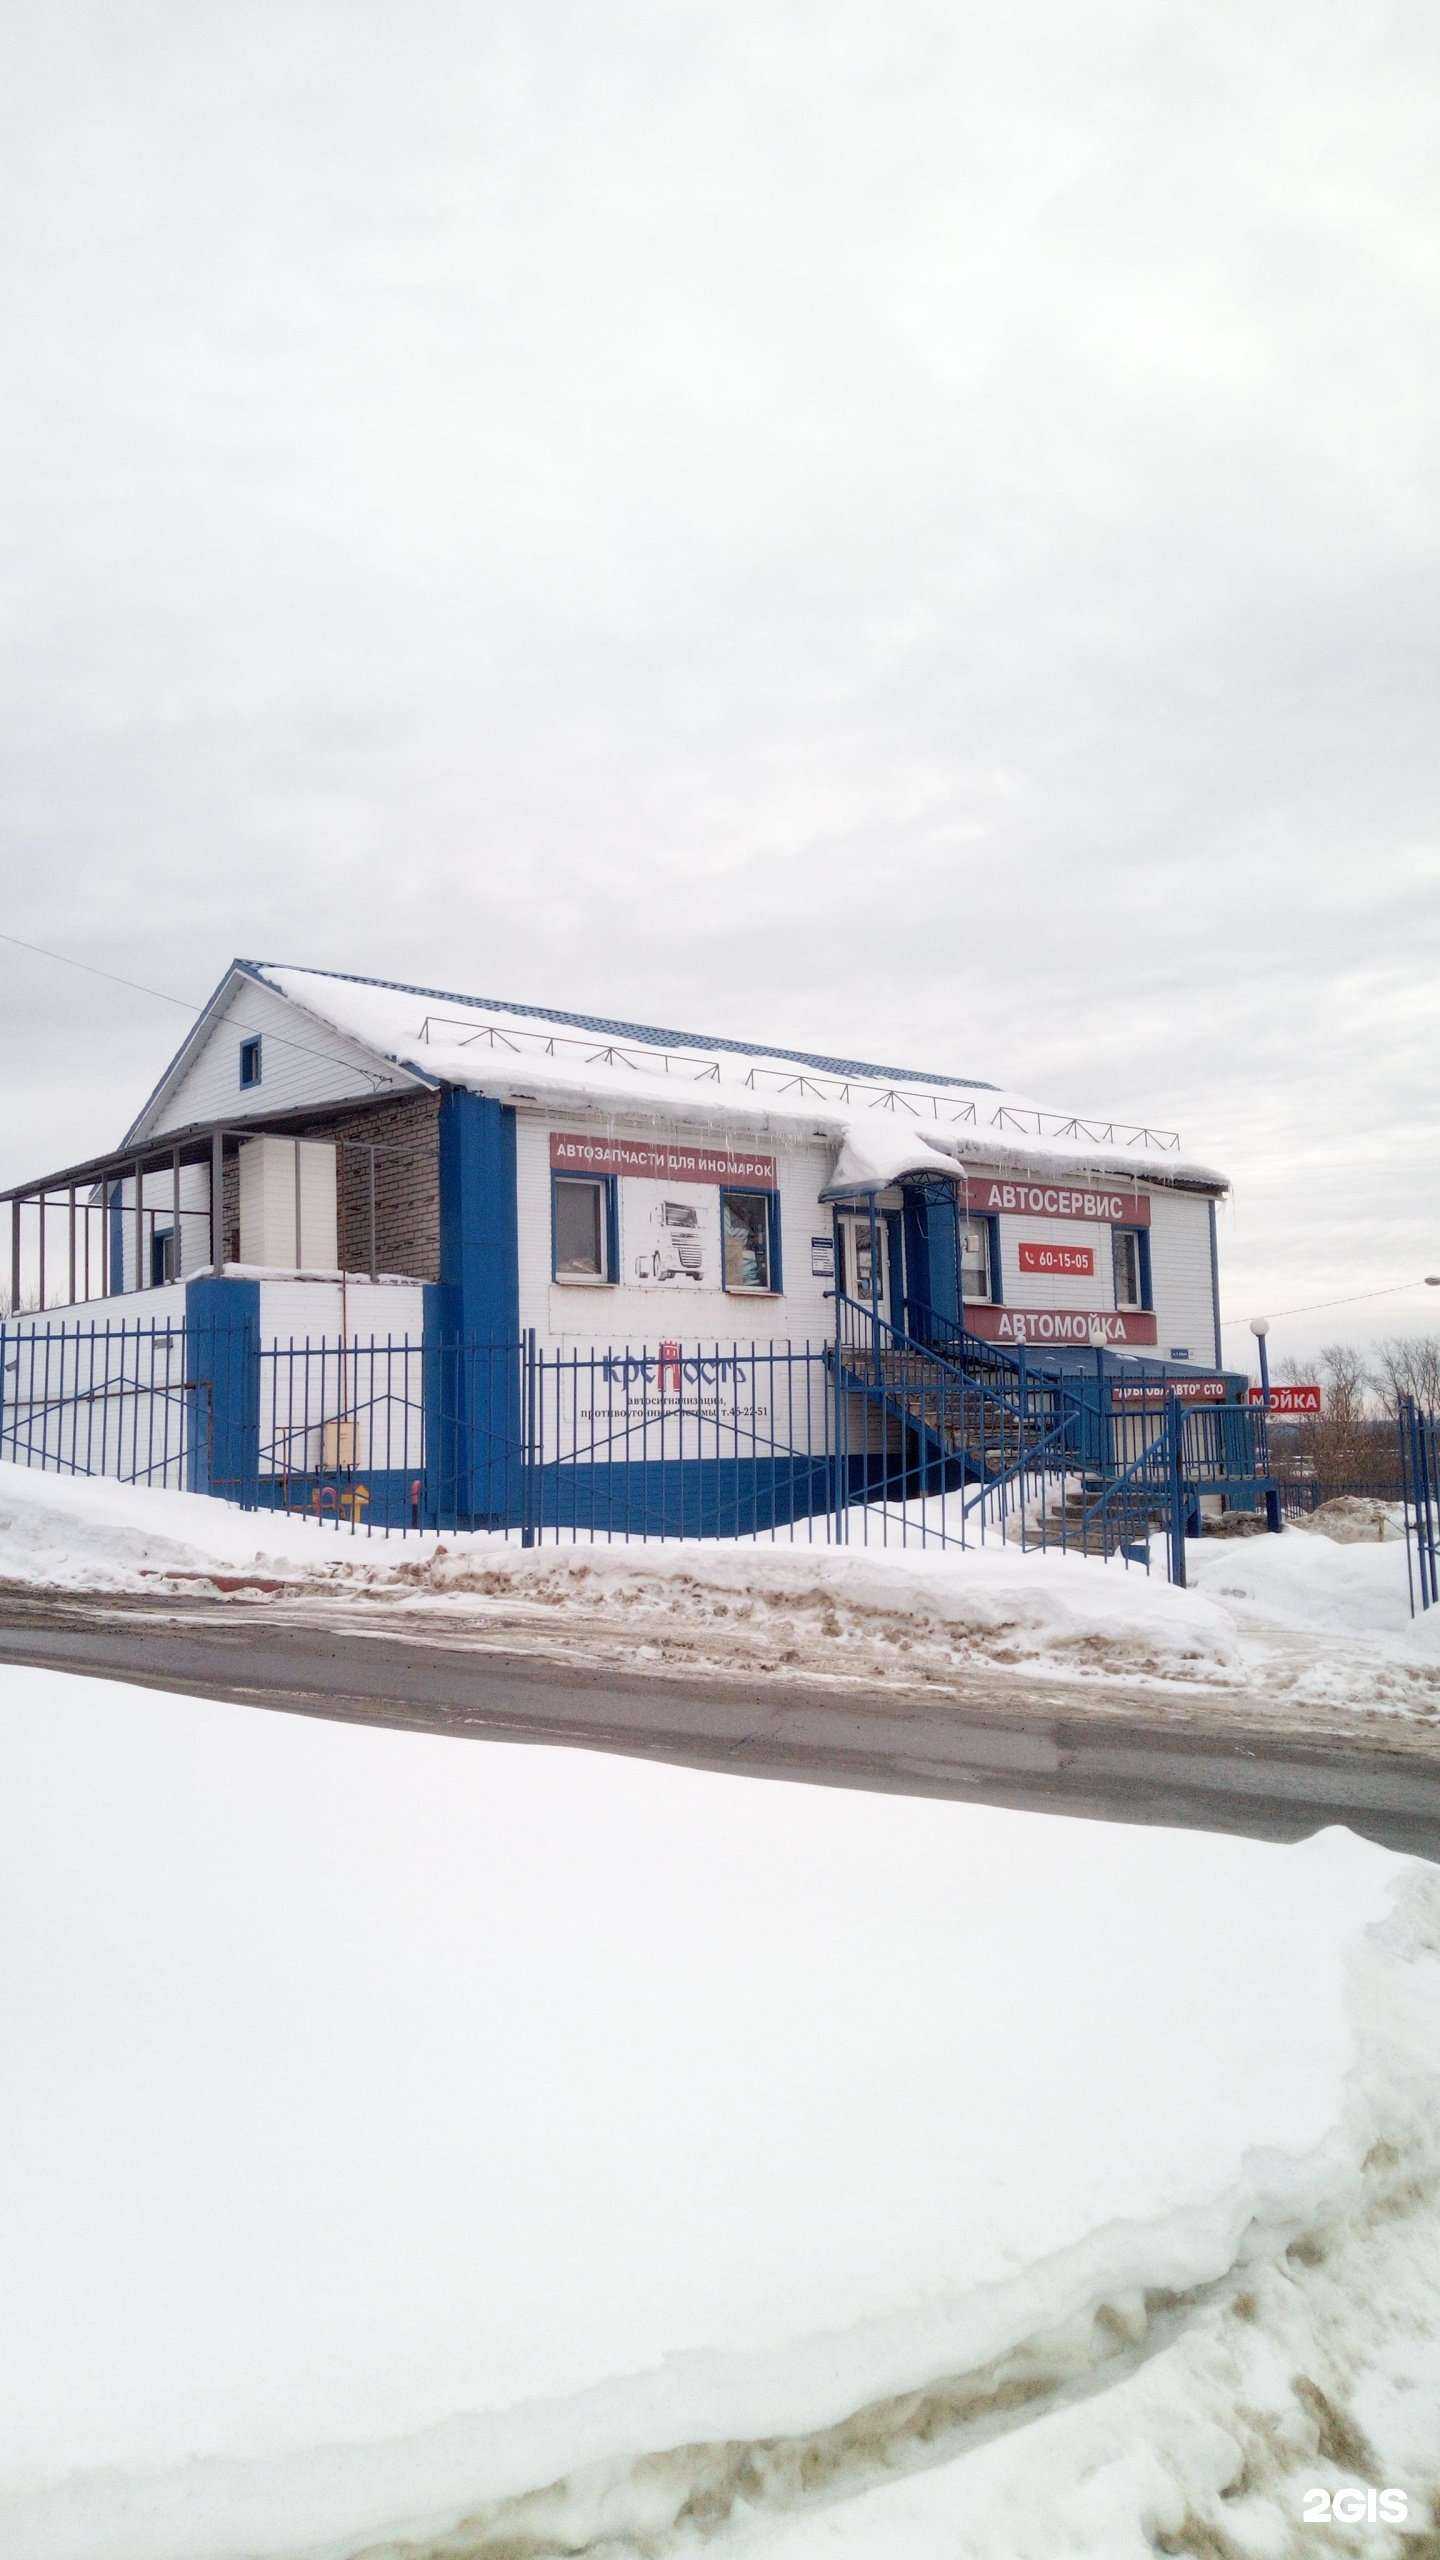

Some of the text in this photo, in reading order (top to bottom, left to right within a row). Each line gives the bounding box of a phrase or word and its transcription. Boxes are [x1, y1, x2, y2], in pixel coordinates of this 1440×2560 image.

[557, 1143, 773, 1177] АВТОЗАПЧАСТИ ДЛЯ ИНОМАРОК
[988, 1184, 1123, 1219] АВТОСЕРВИС
[1039, 1252, 1089, 1269] 60-15-05
[998, 1313, 1127, 1340] АВТОМОЙКА
[1203, 1383, 1224, 1396] СТО
[1252, 1389, 1318, 1410] МОЙКА
